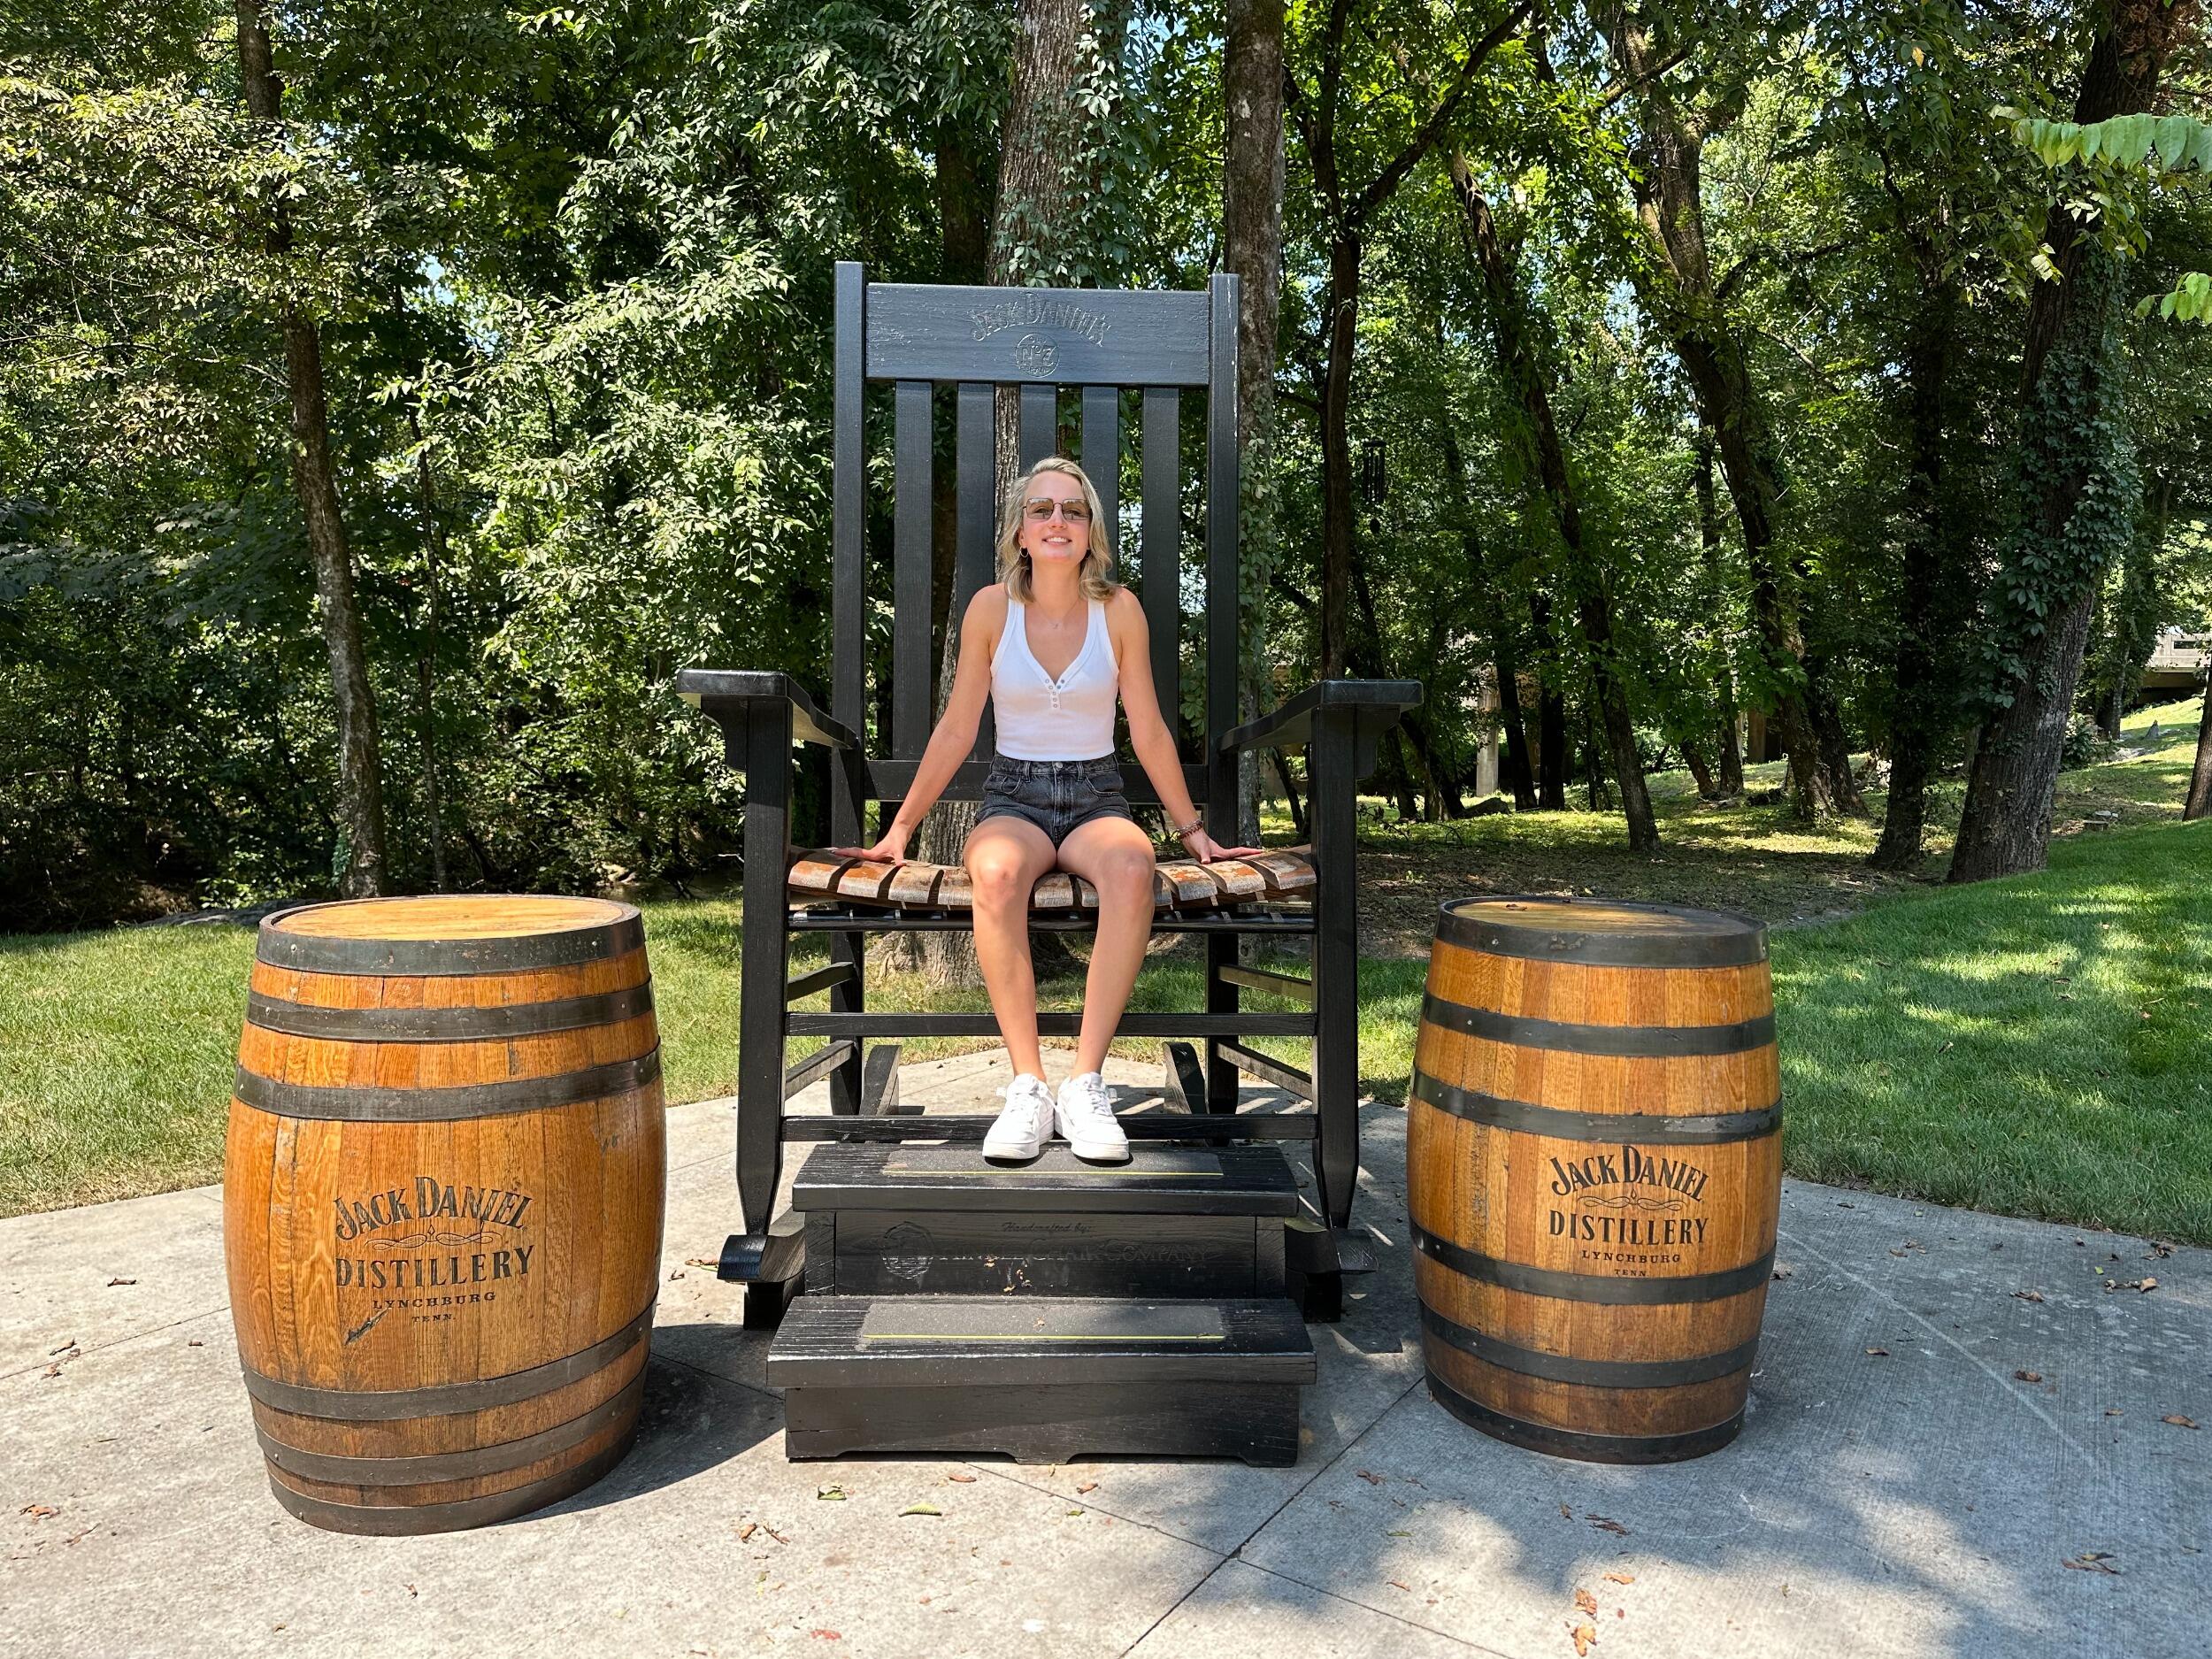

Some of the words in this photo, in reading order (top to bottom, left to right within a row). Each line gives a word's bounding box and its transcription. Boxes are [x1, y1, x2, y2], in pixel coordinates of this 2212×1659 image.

[1550, 1154, 1619, 1196] JACK
[1622, 1145, 1709, 1202] DANIEL
[333, 1188, 413, 1240] JACK
[415, 1176, 534, 1230] DANIEL
[1549, 1210, 1709, 1246] DISTILLERY
[335, 1244, 534, 1289] DISTILLERY
[1581, 1250, 1681, 1263] LYNCHBURG
[373, 1292, 496, 1310] LYNCHBURG
